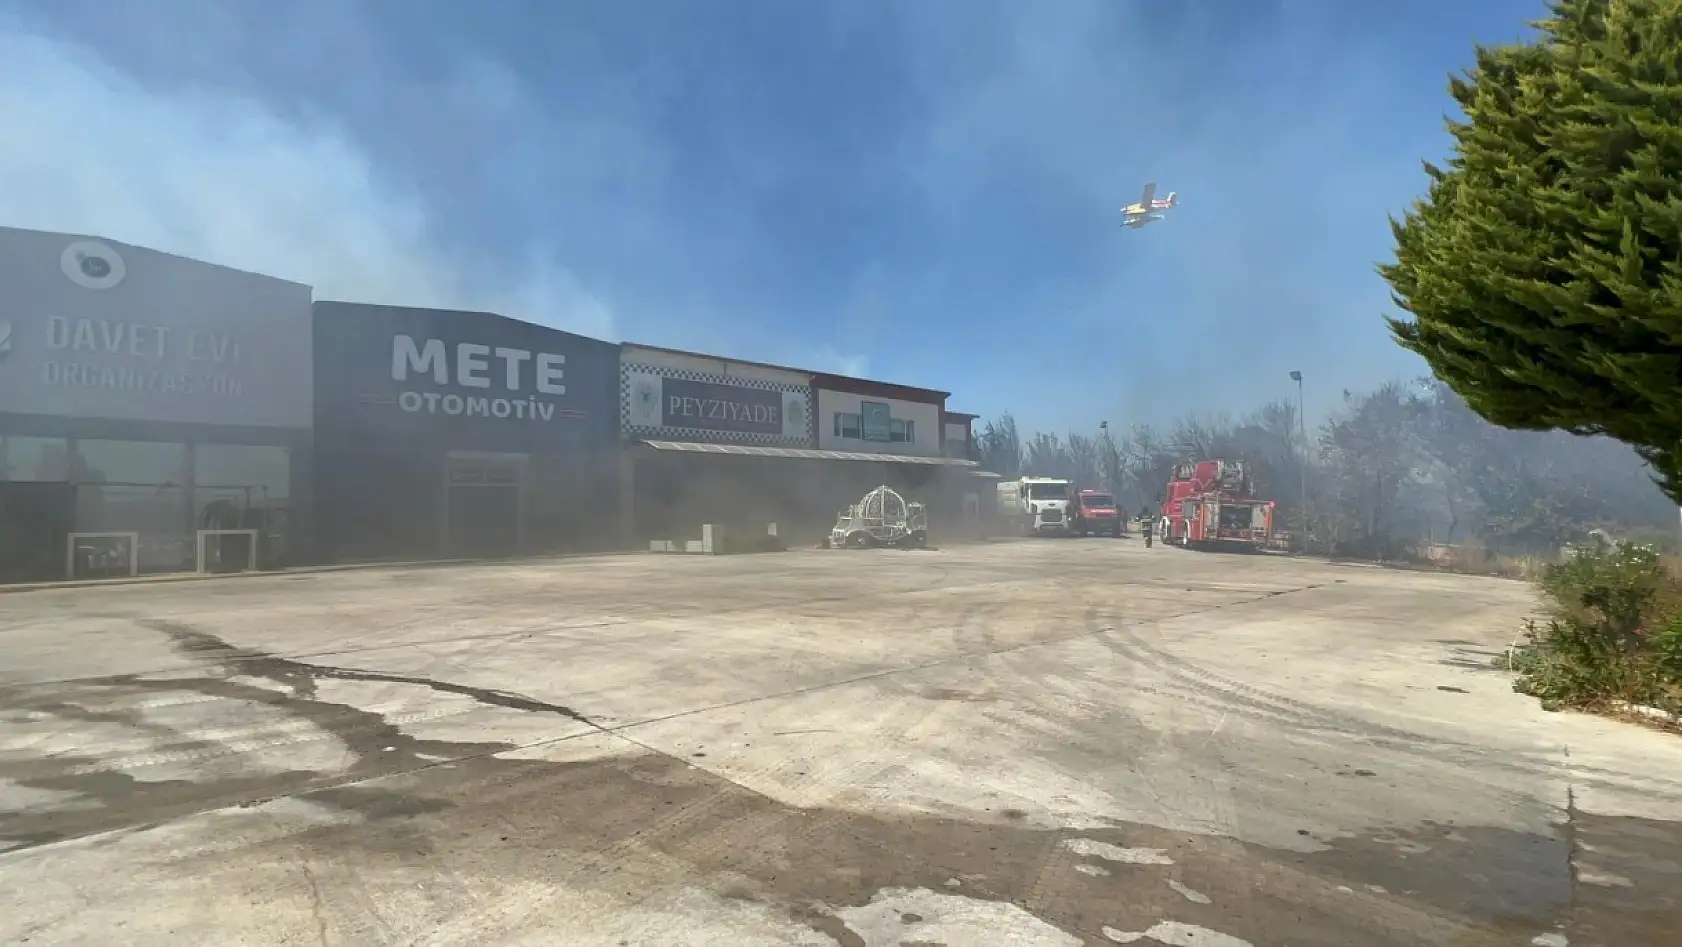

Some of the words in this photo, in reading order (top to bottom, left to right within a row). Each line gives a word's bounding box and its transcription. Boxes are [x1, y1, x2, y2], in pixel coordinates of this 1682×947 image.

[46, 314, 171, 359] DAVET
[391, 334, 566, 396] METE
[399, 391, 555, 421] OTOMOTİV
